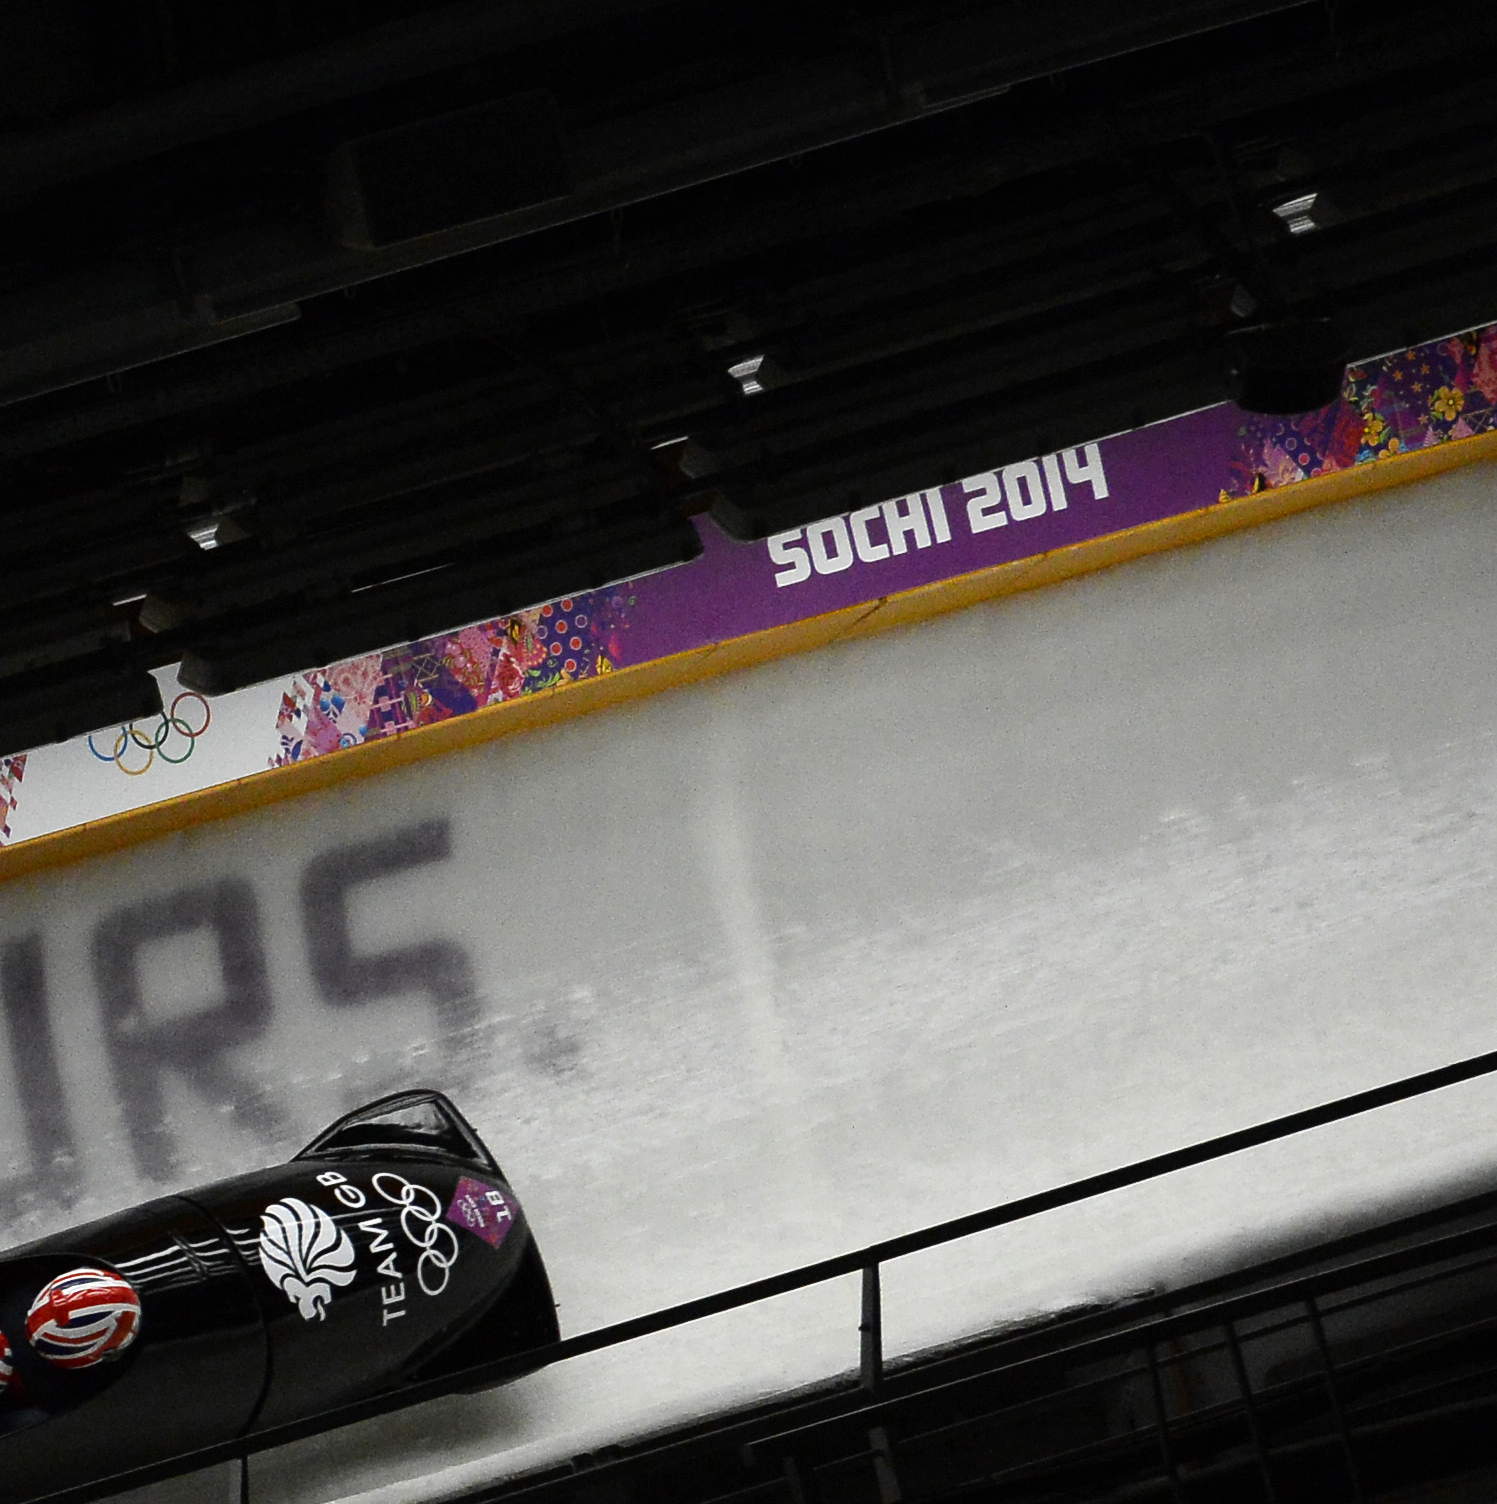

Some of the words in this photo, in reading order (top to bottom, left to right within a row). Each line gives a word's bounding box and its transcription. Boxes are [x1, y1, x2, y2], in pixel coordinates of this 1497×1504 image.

[766, 487, 952, 588] SOCHI
[961, 441, 1110, 535] 2014
[315, 1170, 367, 1209] GB
[358, 1217, 406, 1327] TEAM
